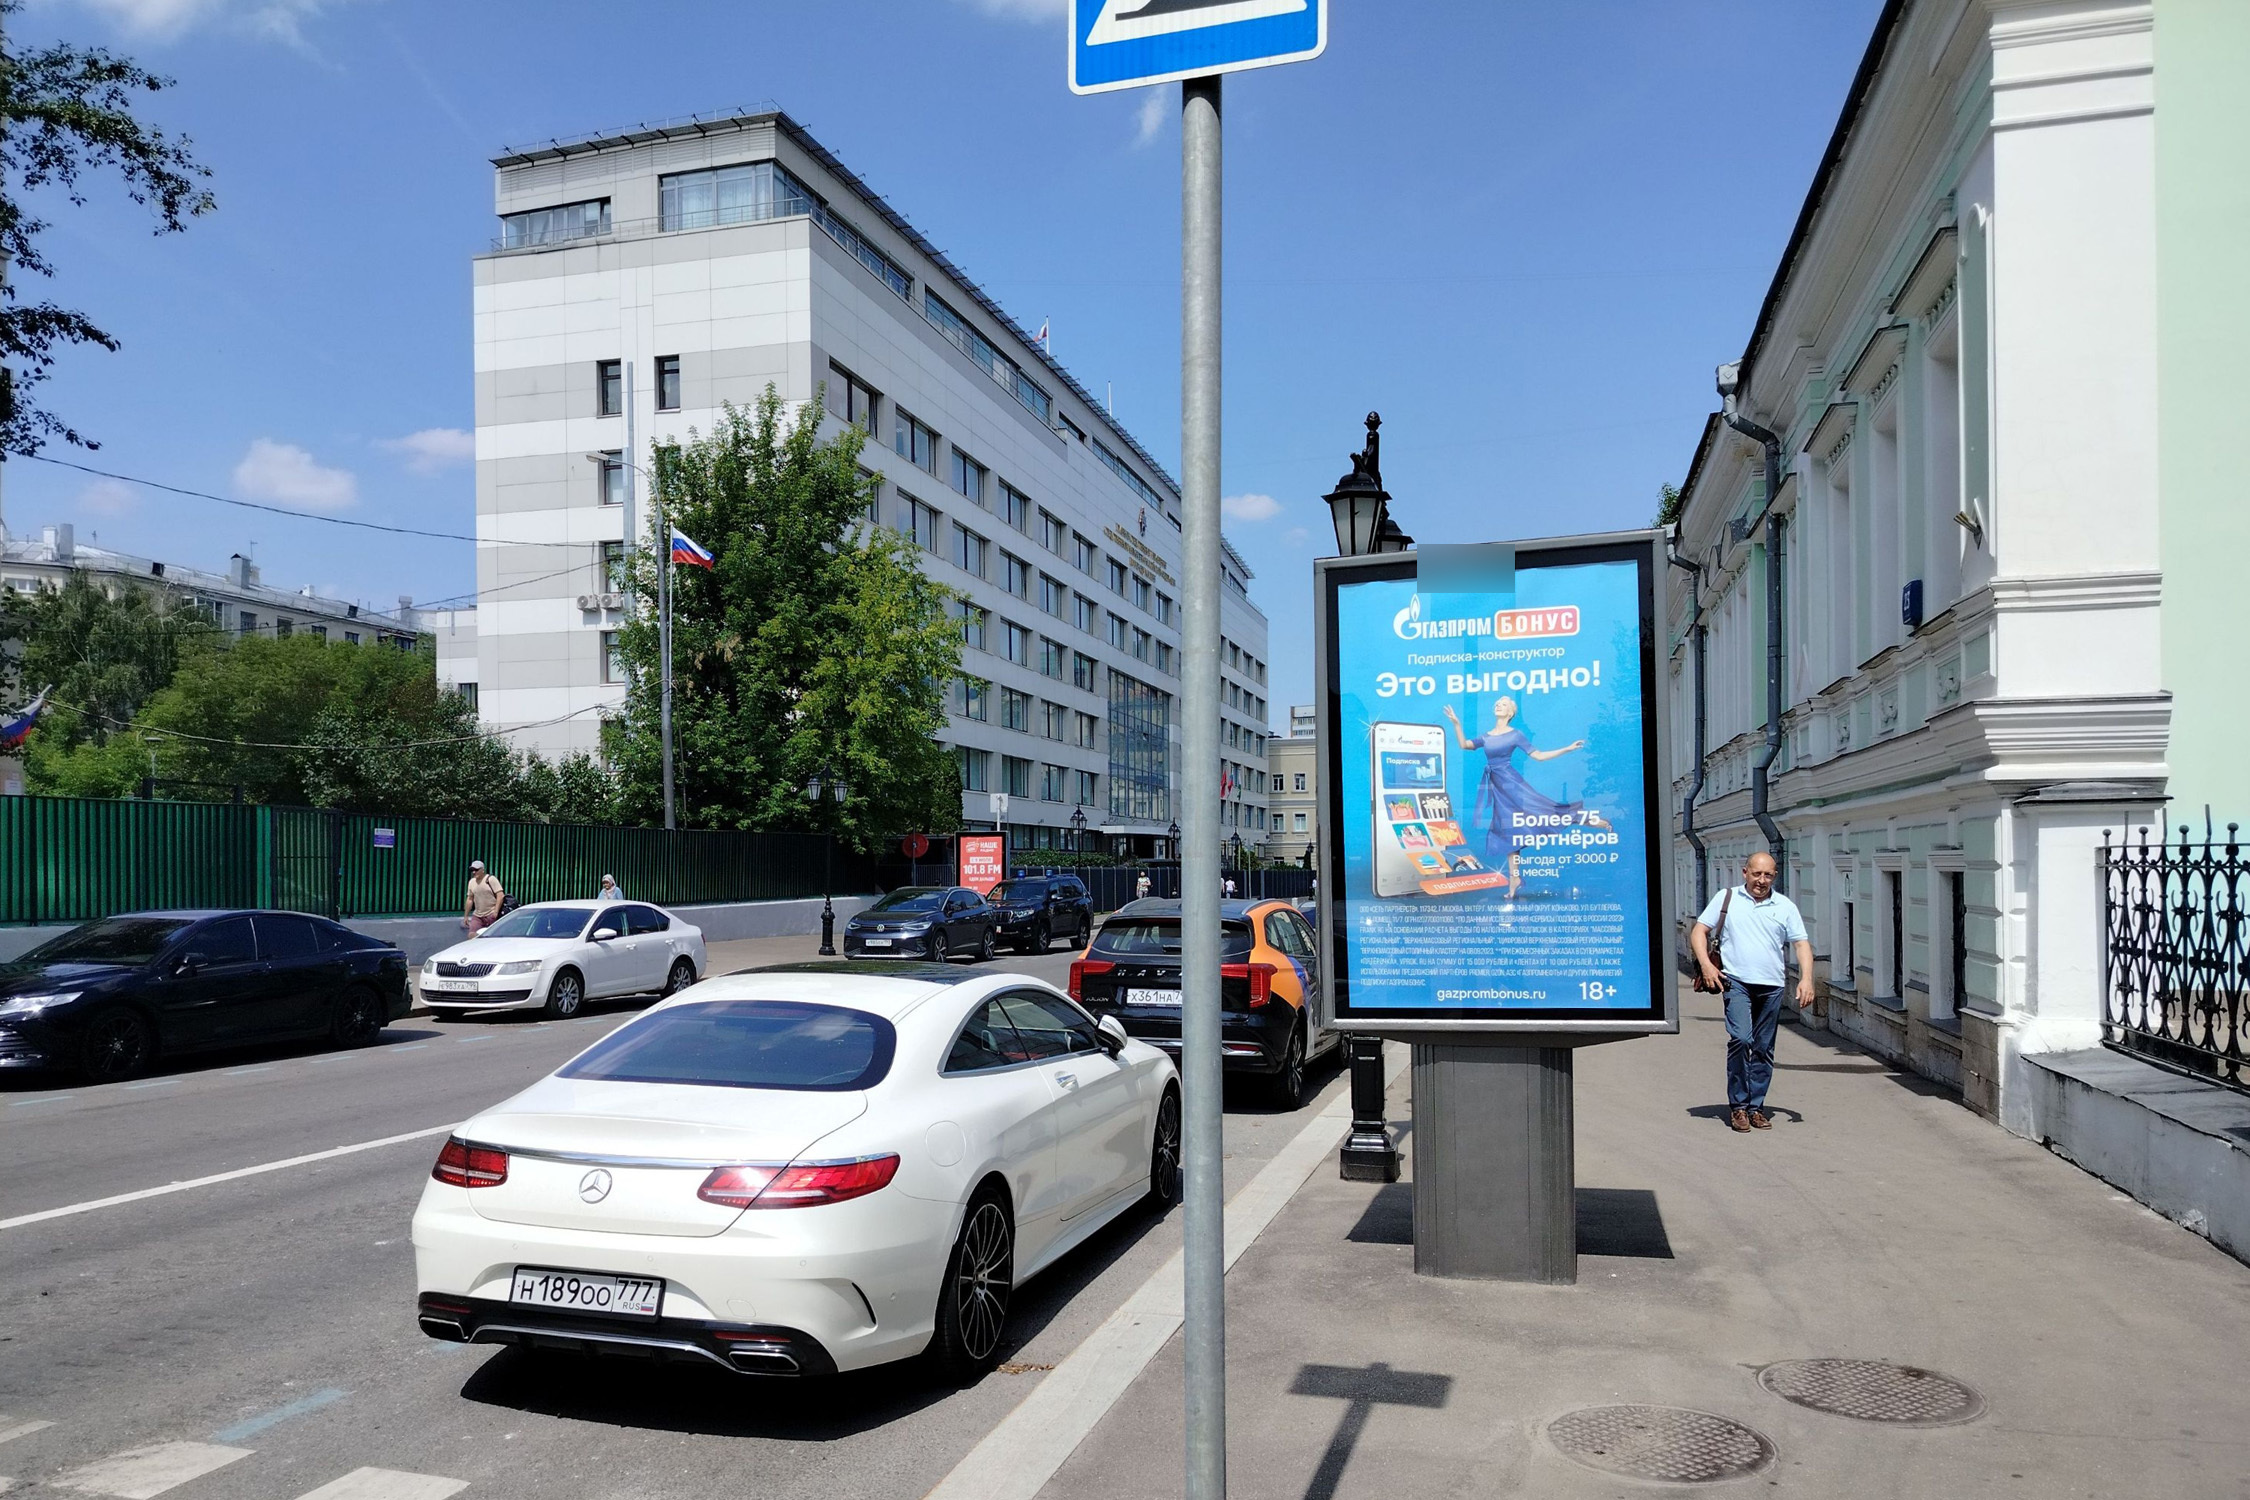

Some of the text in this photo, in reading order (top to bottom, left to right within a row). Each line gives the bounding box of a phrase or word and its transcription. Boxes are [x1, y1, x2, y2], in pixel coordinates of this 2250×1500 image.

[1421, 611, 1575, 639] ГАЗПРОМ БОНУС
[1407, 645, 1566, 667] Подписка-конструктор
[1375, 659, 1602, 698] Это выгодно!
[1386, 757, 1421, 766] Подписка
[1512, 810, 1601, 828] Более 75
[1512, 829, 1619, 851] партнёров
[963, 864, 1001, 874] 101.8 FM
[1513, 854, 1556, 868] Выгода
[1558, 856, 1572, 865] от
[1574, 853, 1607, 864] 3000
[1512, 868, 1520, 877] в
[1433, 877, 1499, 890] ПОДПИСАТЬСЯ
[1437, 981, 1618, 1001] gazprombonus.ru 18+
[617, 1279, 653, 1302] 777
[622, 1302, 641, 1311] RUS
